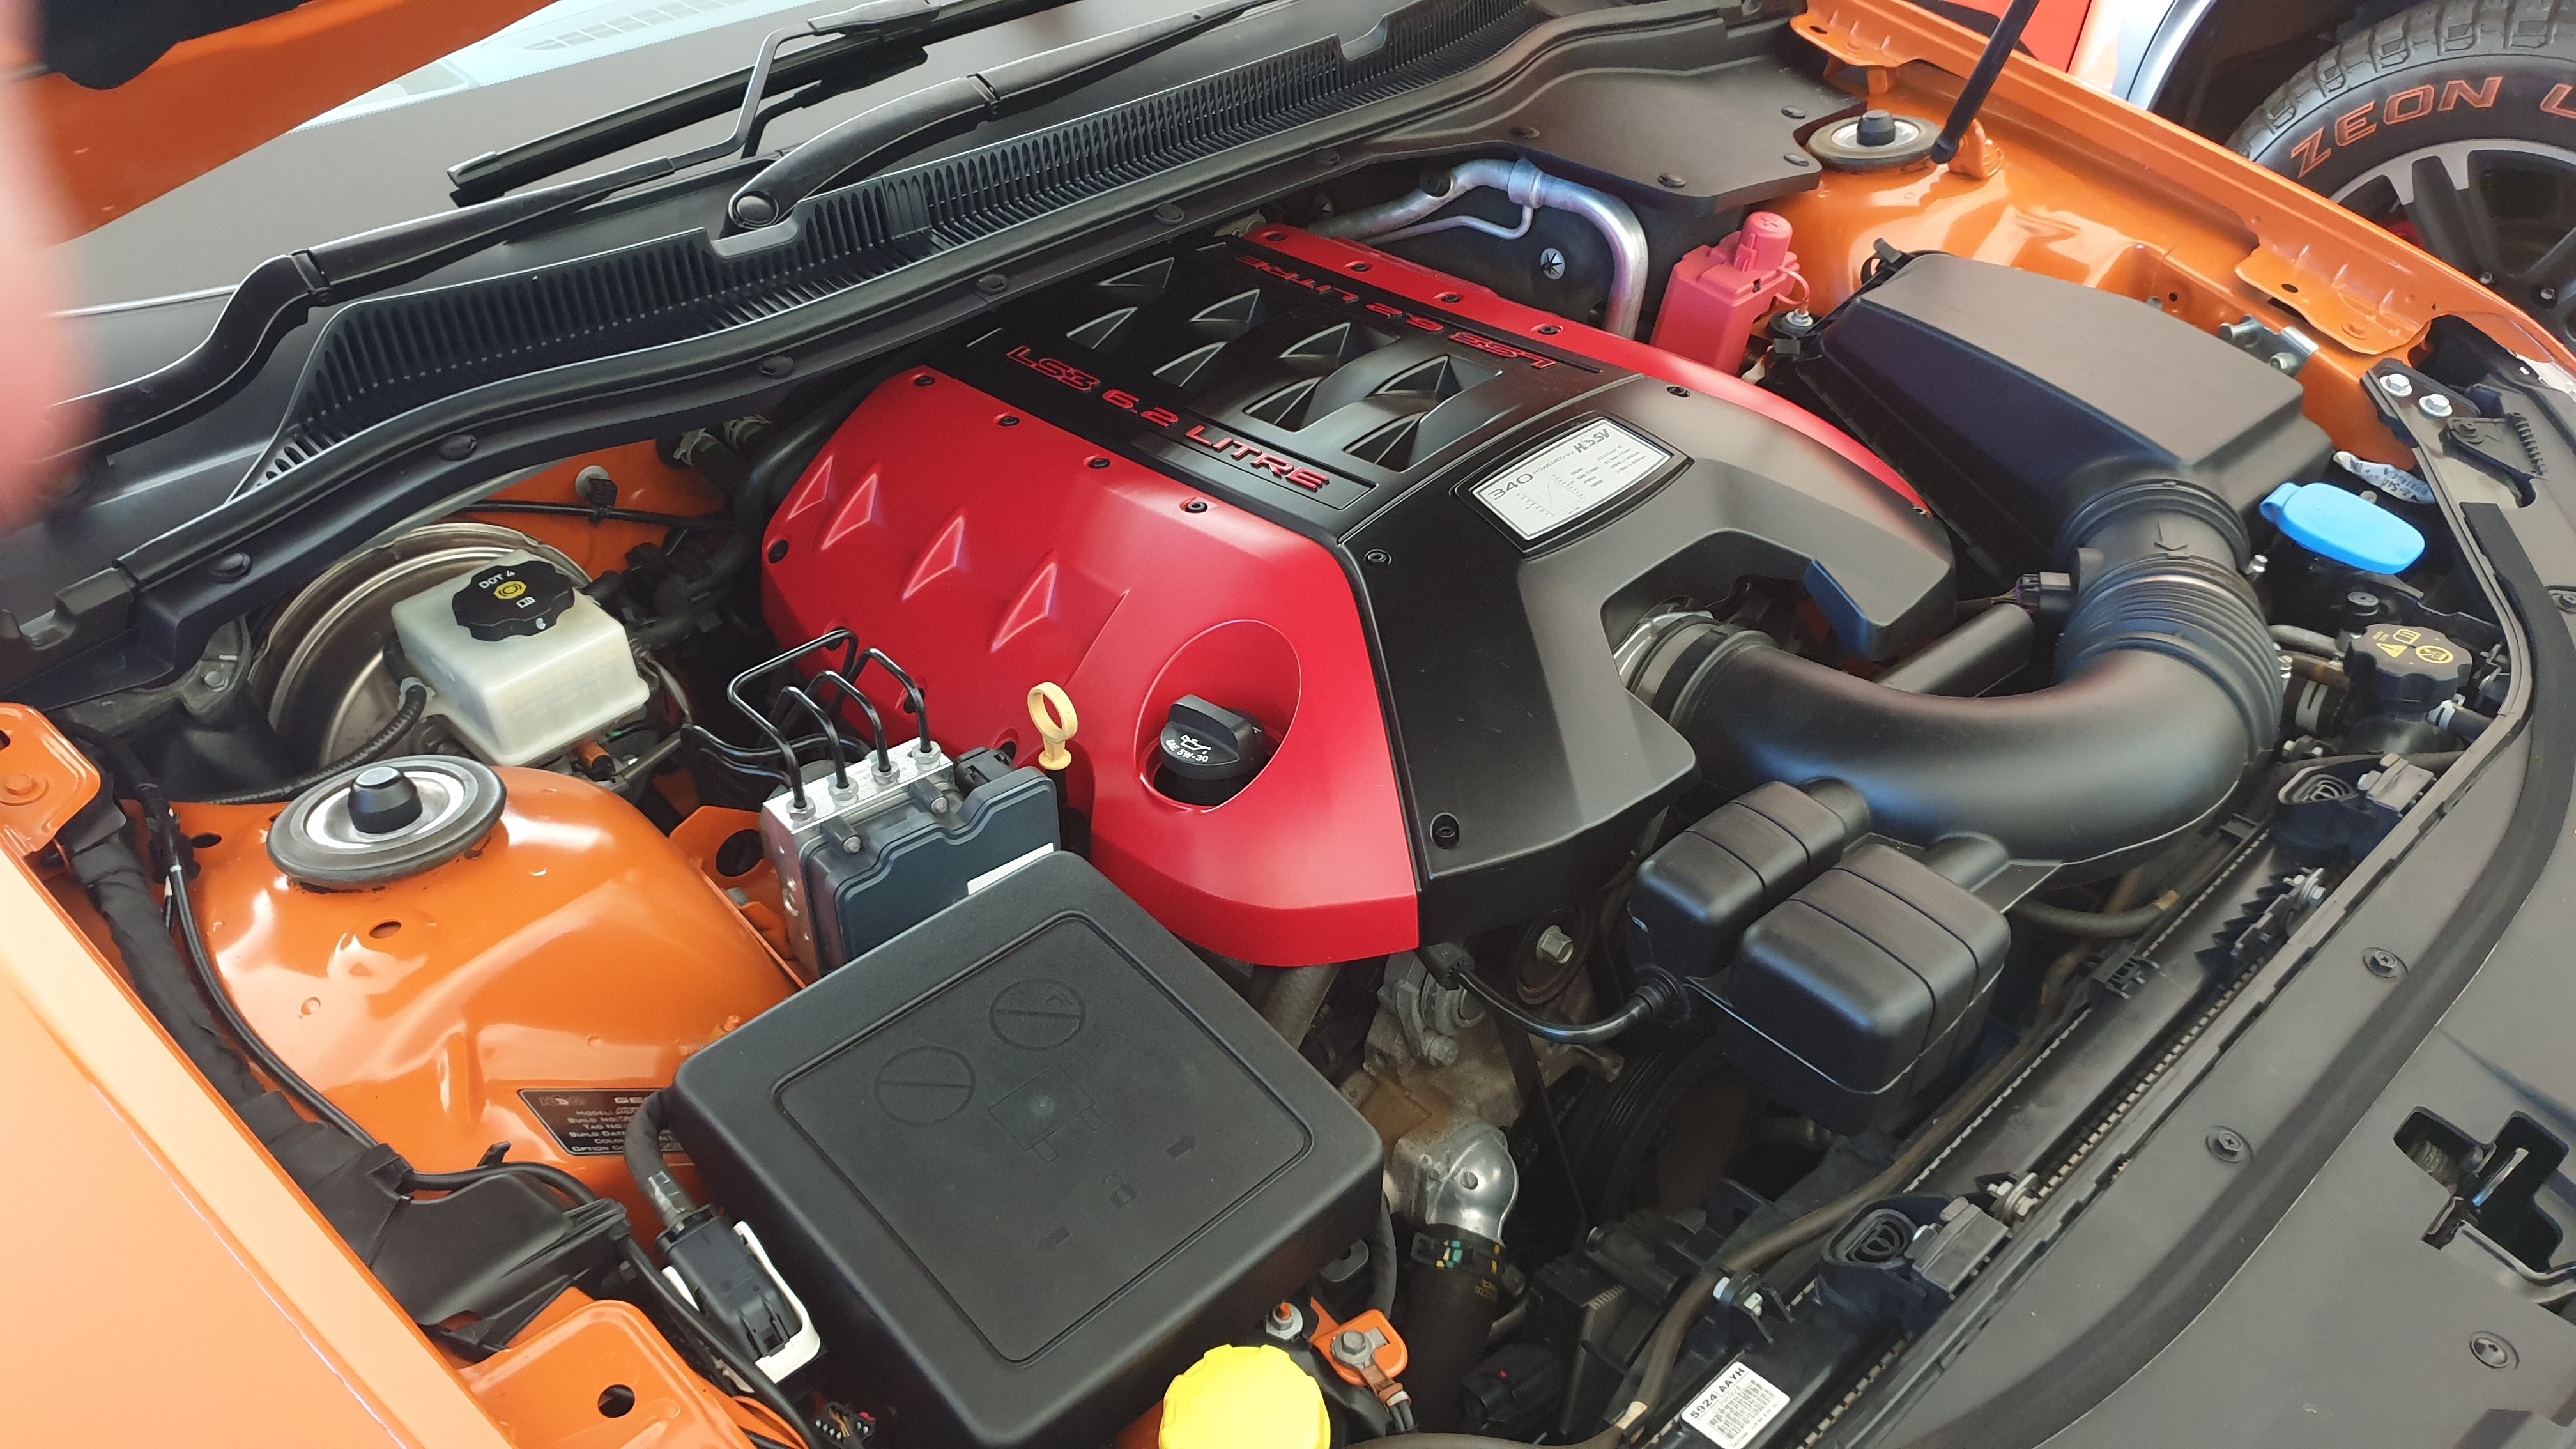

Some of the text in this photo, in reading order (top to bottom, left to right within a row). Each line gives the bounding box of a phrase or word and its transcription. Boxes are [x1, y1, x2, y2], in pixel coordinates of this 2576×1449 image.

[2290, 75, 2504, 179] ZEON
[1236, 255, 1556, 369] LS3 6.2 LITRE
[1006, 345, 1330, 491] LS3 6.2 LITRE
[1487, 473, 1533, 500] 340
[479, 573, 503, 588] DOT
[1165, 739, 1209, 762] SAE 5W-30
[1690, 1367, 1745, 1419] 5924 AAYH
